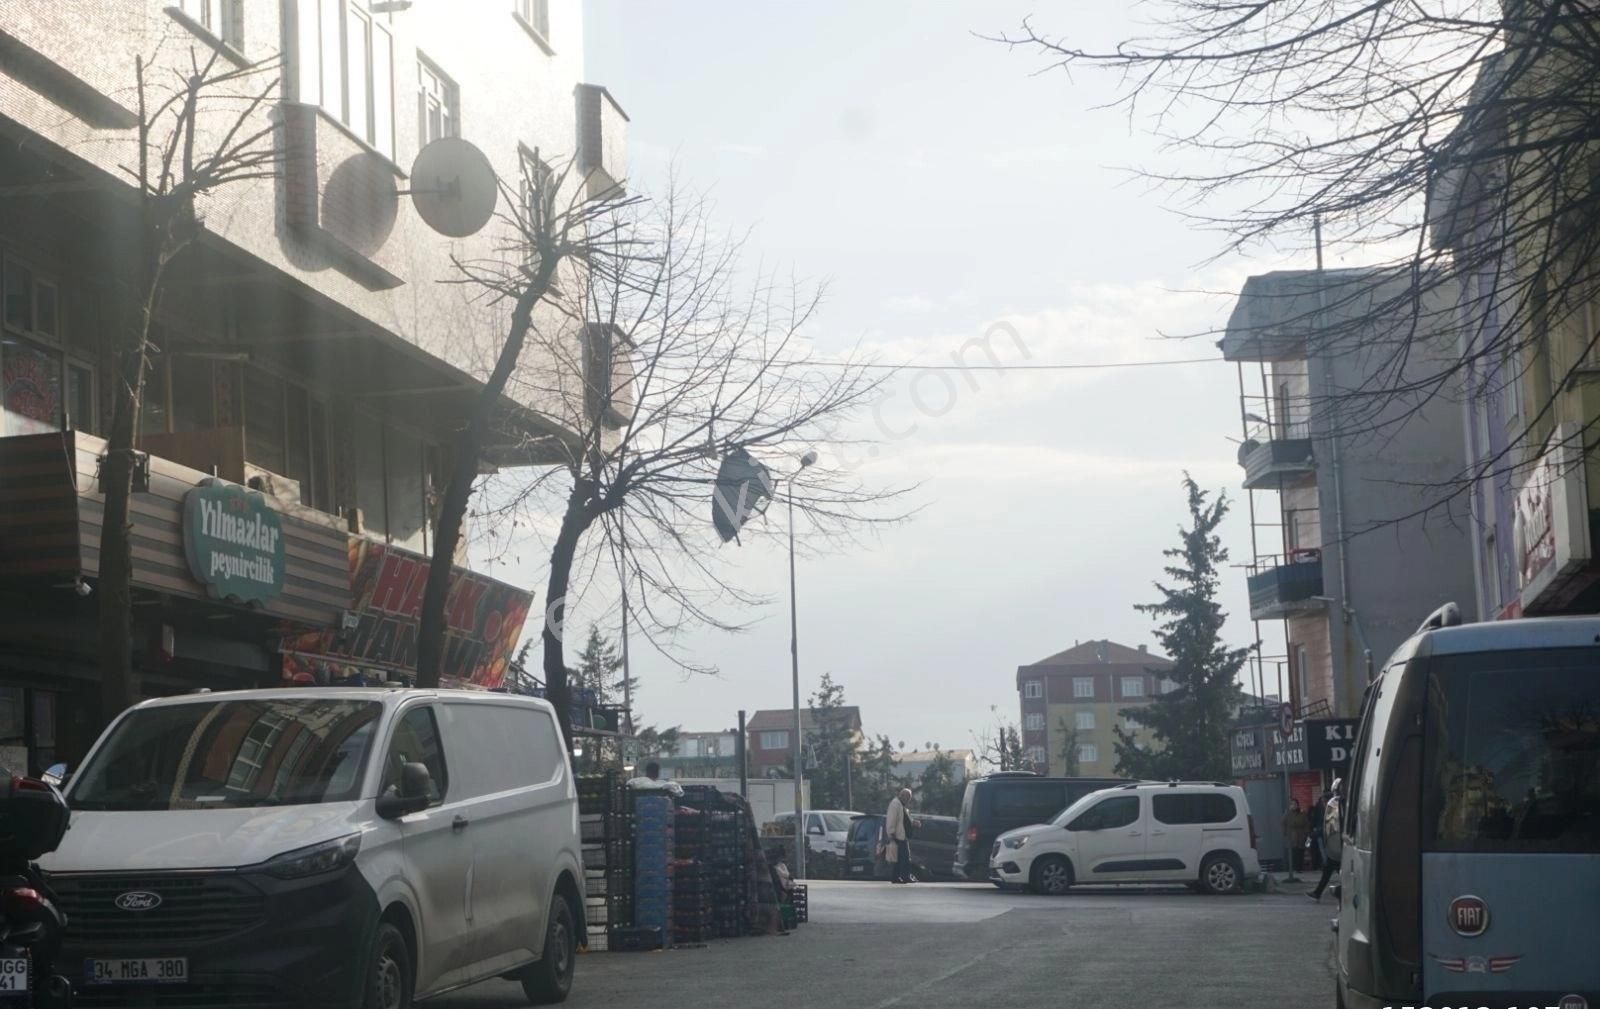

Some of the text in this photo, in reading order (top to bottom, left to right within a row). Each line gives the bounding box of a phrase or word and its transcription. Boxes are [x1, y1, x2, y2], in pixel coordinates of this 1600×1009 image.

[209, 550, 275, 585] peynircilik
[122, 893, 153, 908] Ford
[1456, 907, 1482, 926] FIAT
[0, 960, 25, 974] GG
[95, 961, 113, 978] 34
[157, 960, 184, 977] 380
